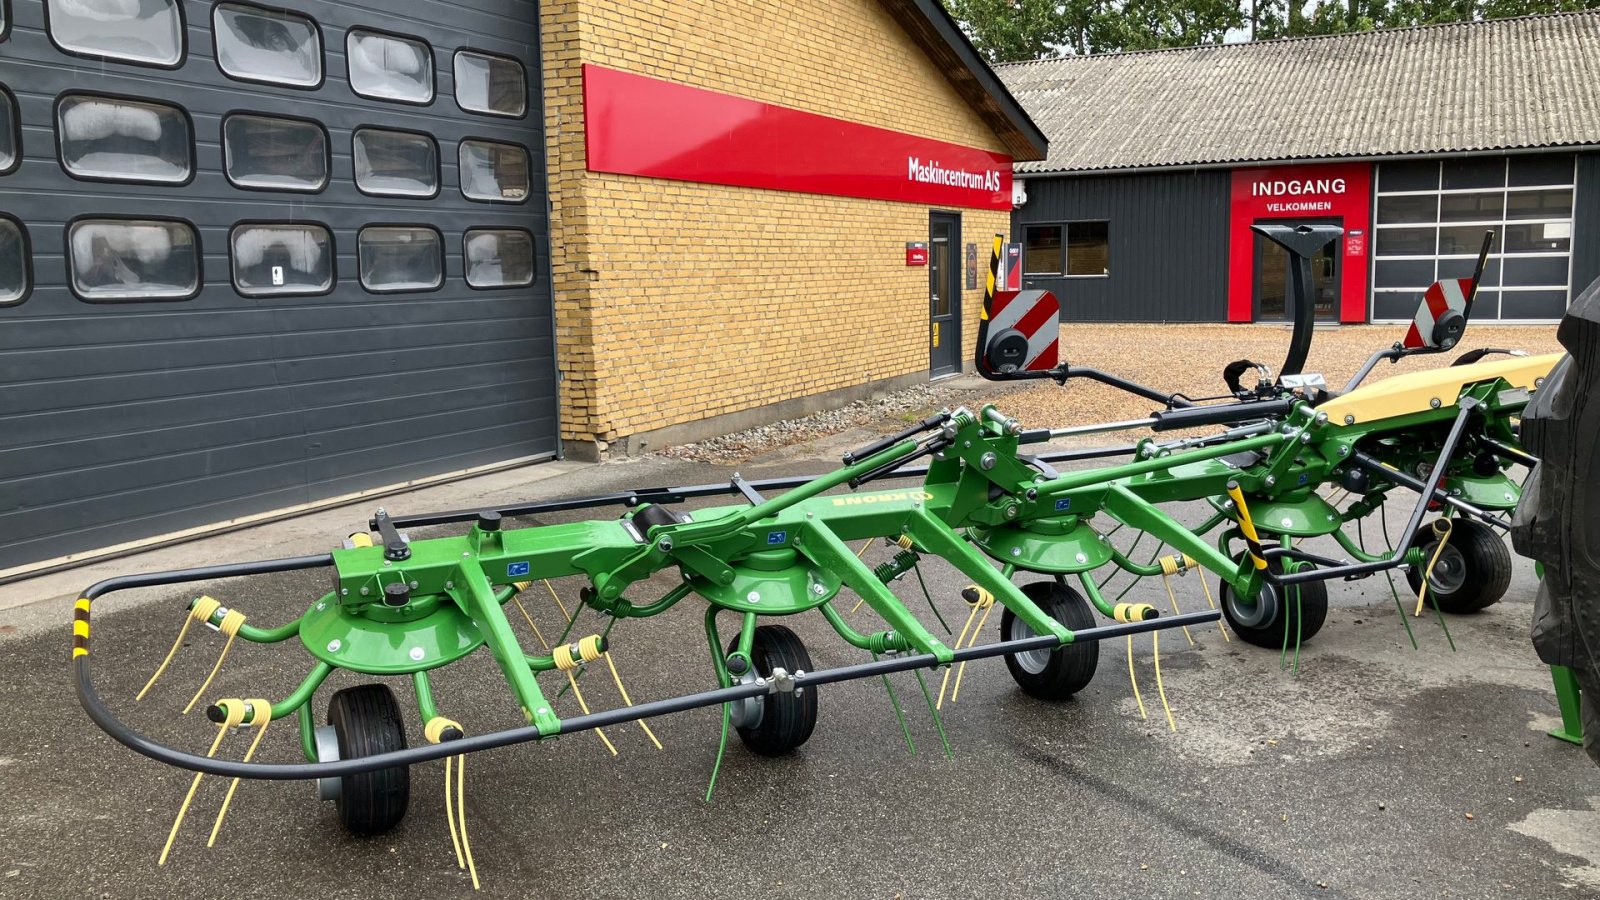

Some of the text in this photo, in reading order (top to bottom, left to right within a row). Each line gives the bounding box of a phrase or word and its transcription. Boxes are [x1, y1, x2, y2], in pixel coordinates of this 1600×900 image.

[908, 156, 1001, 192] Maskincentrum A/S
[1252, 178, 1346, 196] INDGANG
[1266, 201, 1332, 212] VELKOMMEN
[832, 493, 907, 506] KRONE
